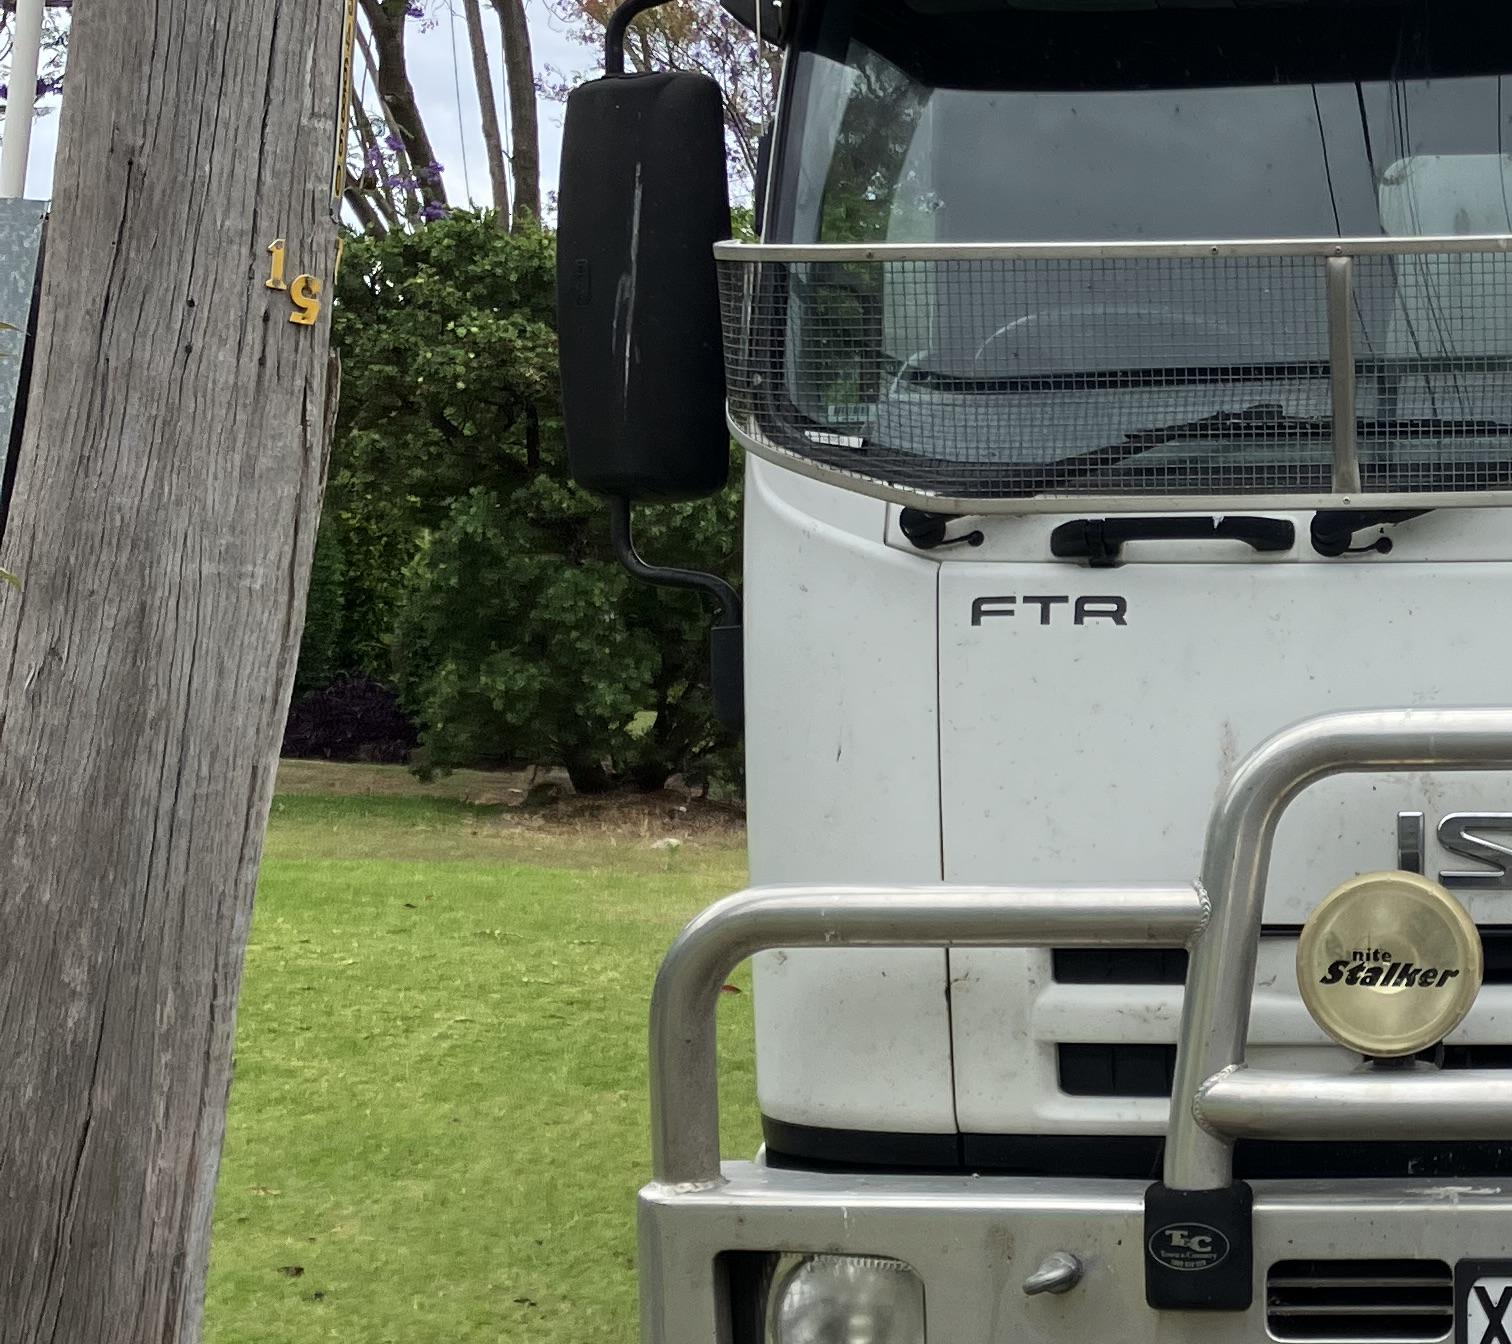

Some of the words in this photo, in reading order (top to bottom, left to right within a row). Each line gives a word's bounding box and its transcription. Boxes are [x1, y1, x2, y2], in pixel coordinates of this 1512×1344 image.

[971, 595, 1127, 626] FTR
[1352, 948, 1392, 962] nite
[1319, 960, 1459, 988] Stalker
